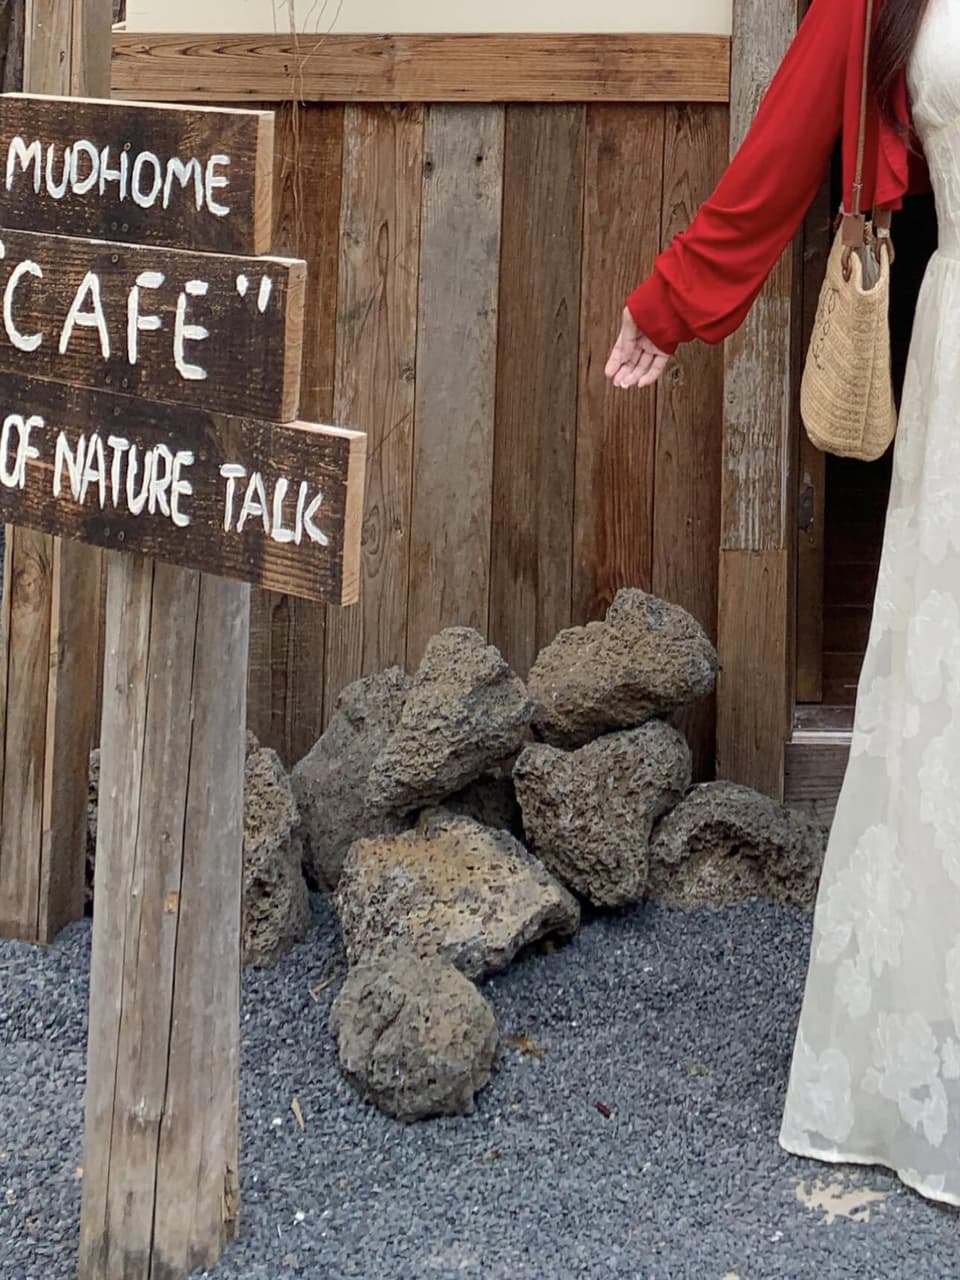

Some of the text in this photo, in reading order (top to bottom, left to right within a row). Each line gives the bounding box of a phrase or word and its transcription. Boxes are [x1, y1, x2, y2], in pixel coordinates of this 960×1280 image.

[6, 136, 231, 216] MUDHOME
[0, 414, 329, 546] OF NATURE TALK
